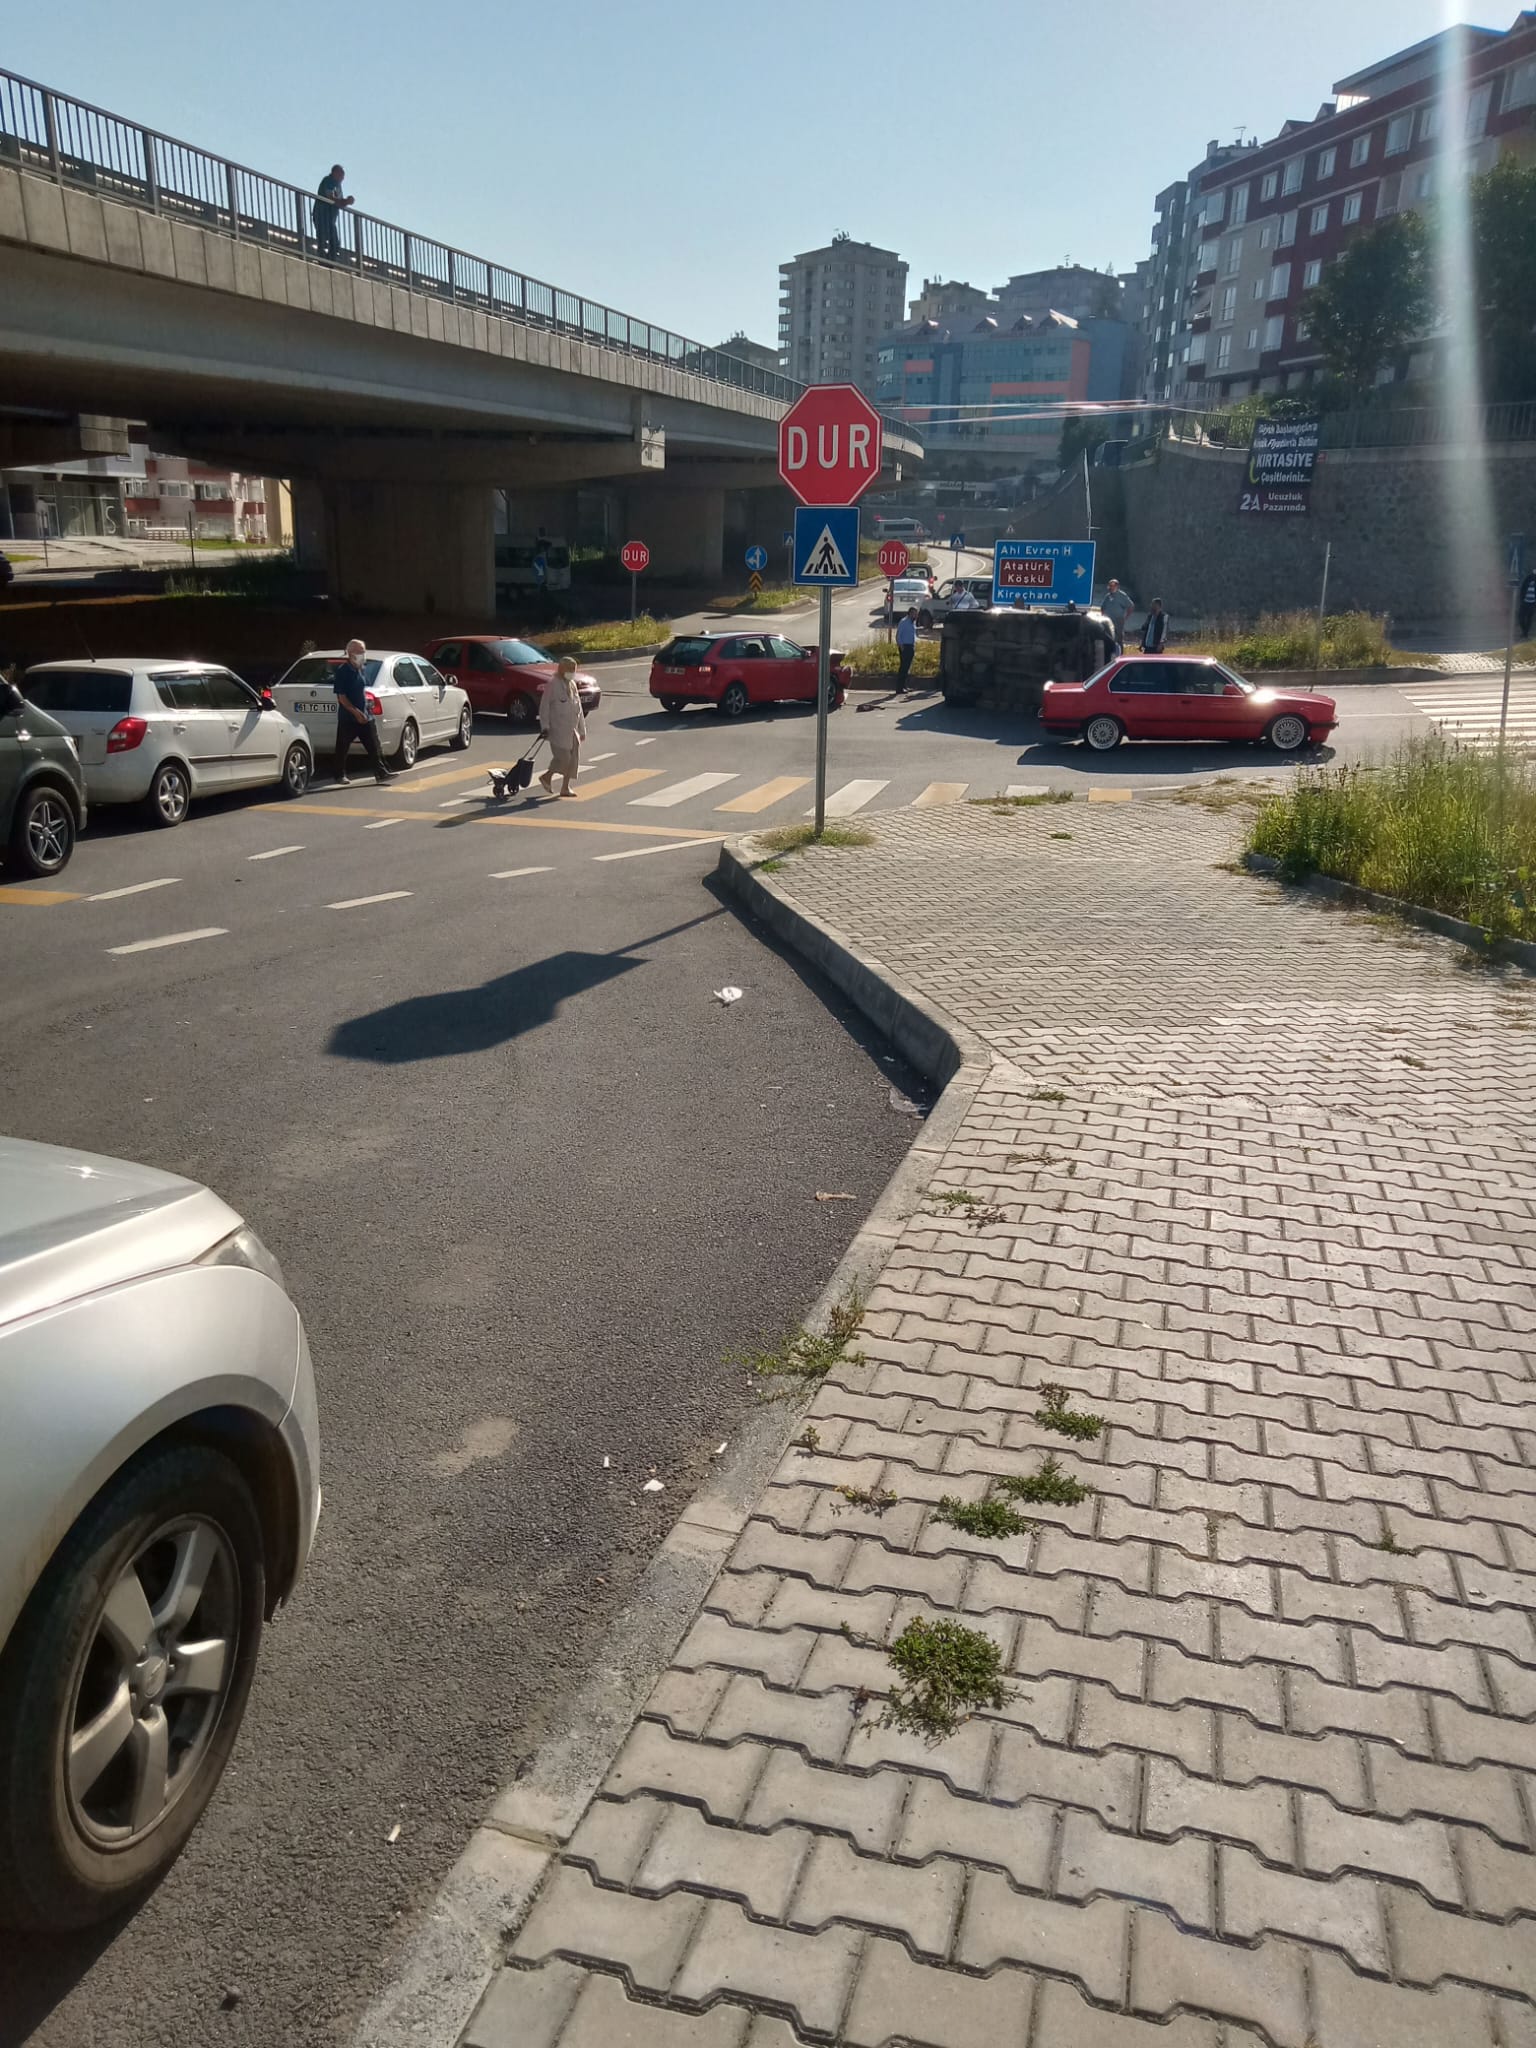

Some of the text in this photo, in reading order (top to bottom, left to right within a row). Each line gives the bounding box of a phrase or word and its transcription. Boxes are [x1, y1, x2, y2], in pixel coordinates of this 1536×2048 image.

[788, 424, 870, 470] DUR
[1256, 449, 1314, 468] KIRTASİYE
[1268, 492, 1303, 501] Ucuzluk
[1262, 503, 1306, 511] Pazarında
[1025, 545, 1059, 555] Evren
[624, 550, 646, 562] DUR
[880, 551, 906, 566] DUR
[1003, 561, 1051, 571] Atatürk
[1007, 573, 1045, 584] Köşkü
